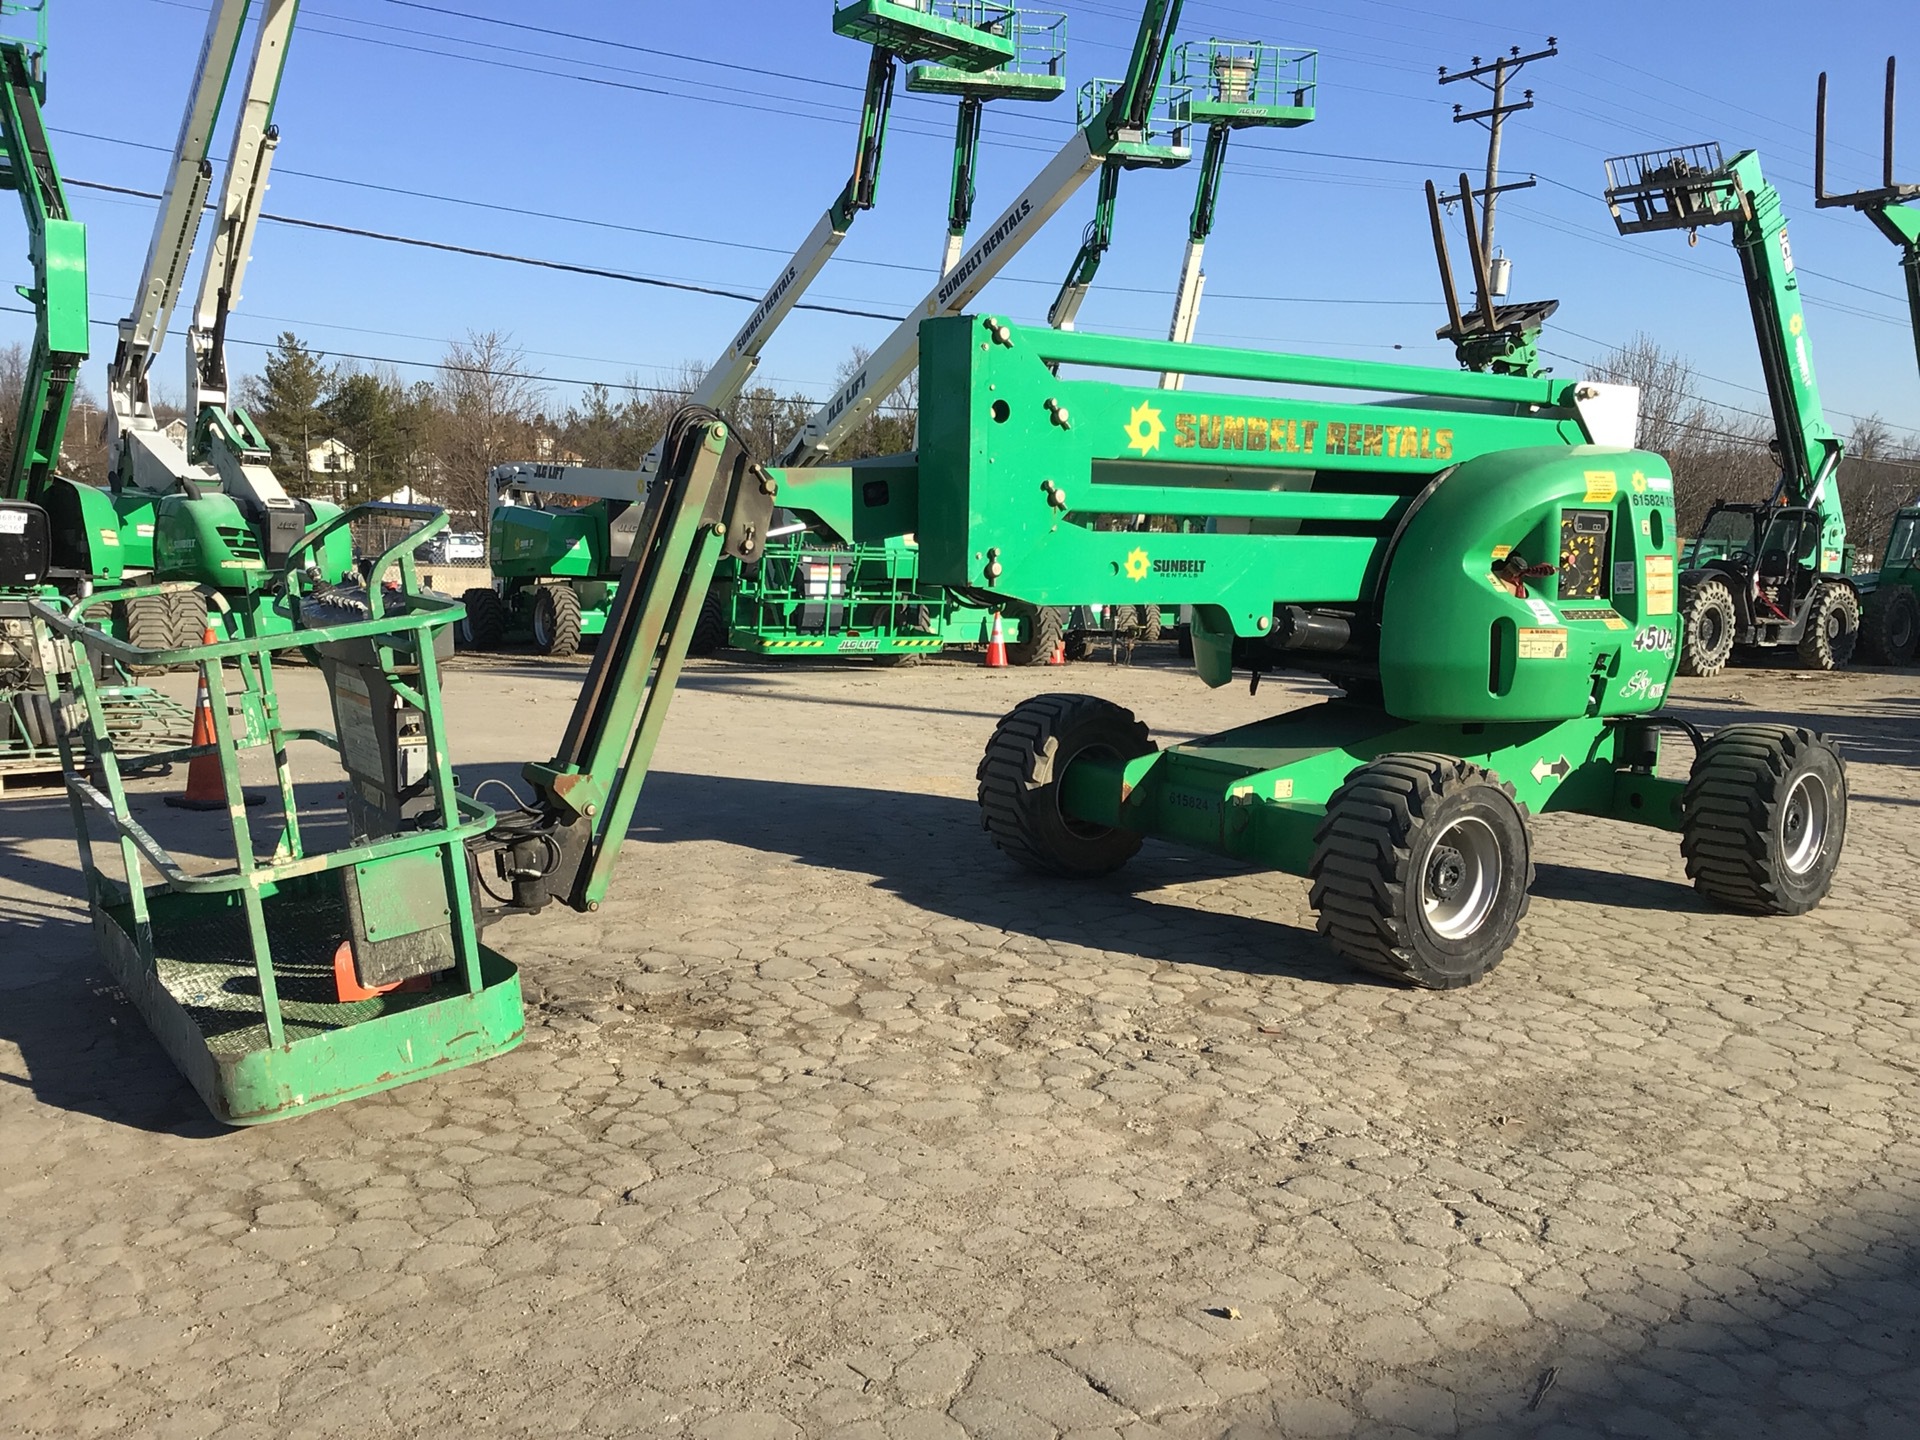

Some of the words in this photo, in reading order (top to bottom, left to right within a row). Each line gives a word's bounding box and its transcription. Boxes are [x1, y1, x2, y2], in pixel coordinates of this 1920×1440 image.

[938, 248, 982, 304] SUNBELT
[982, 199, 1031, 258] RENTALS
[1777, 228, 1795, 276] JCB
[736, 307, 766, 352] SUNBELT
[764, 266, 796, 314] RENTALS
[827, 395, 843, 426] JLG
[846, 370, 867, 406] LIFT
[1174, 413, 1319, 454] SUNBELT
[1326, 421, 1454, 459] RENTALS
[534, 464, 547, 479] JLG
[550, 466, 565, 480] LIFT
[1632, 493, 1664, 507] 615824
[1153, 559, 1206, 573] SUNBELT
[839, 639, 857, 649] JLG
[858, 638, 881, 649] LIFT
[1169, 792, 1208, 811] 615824
